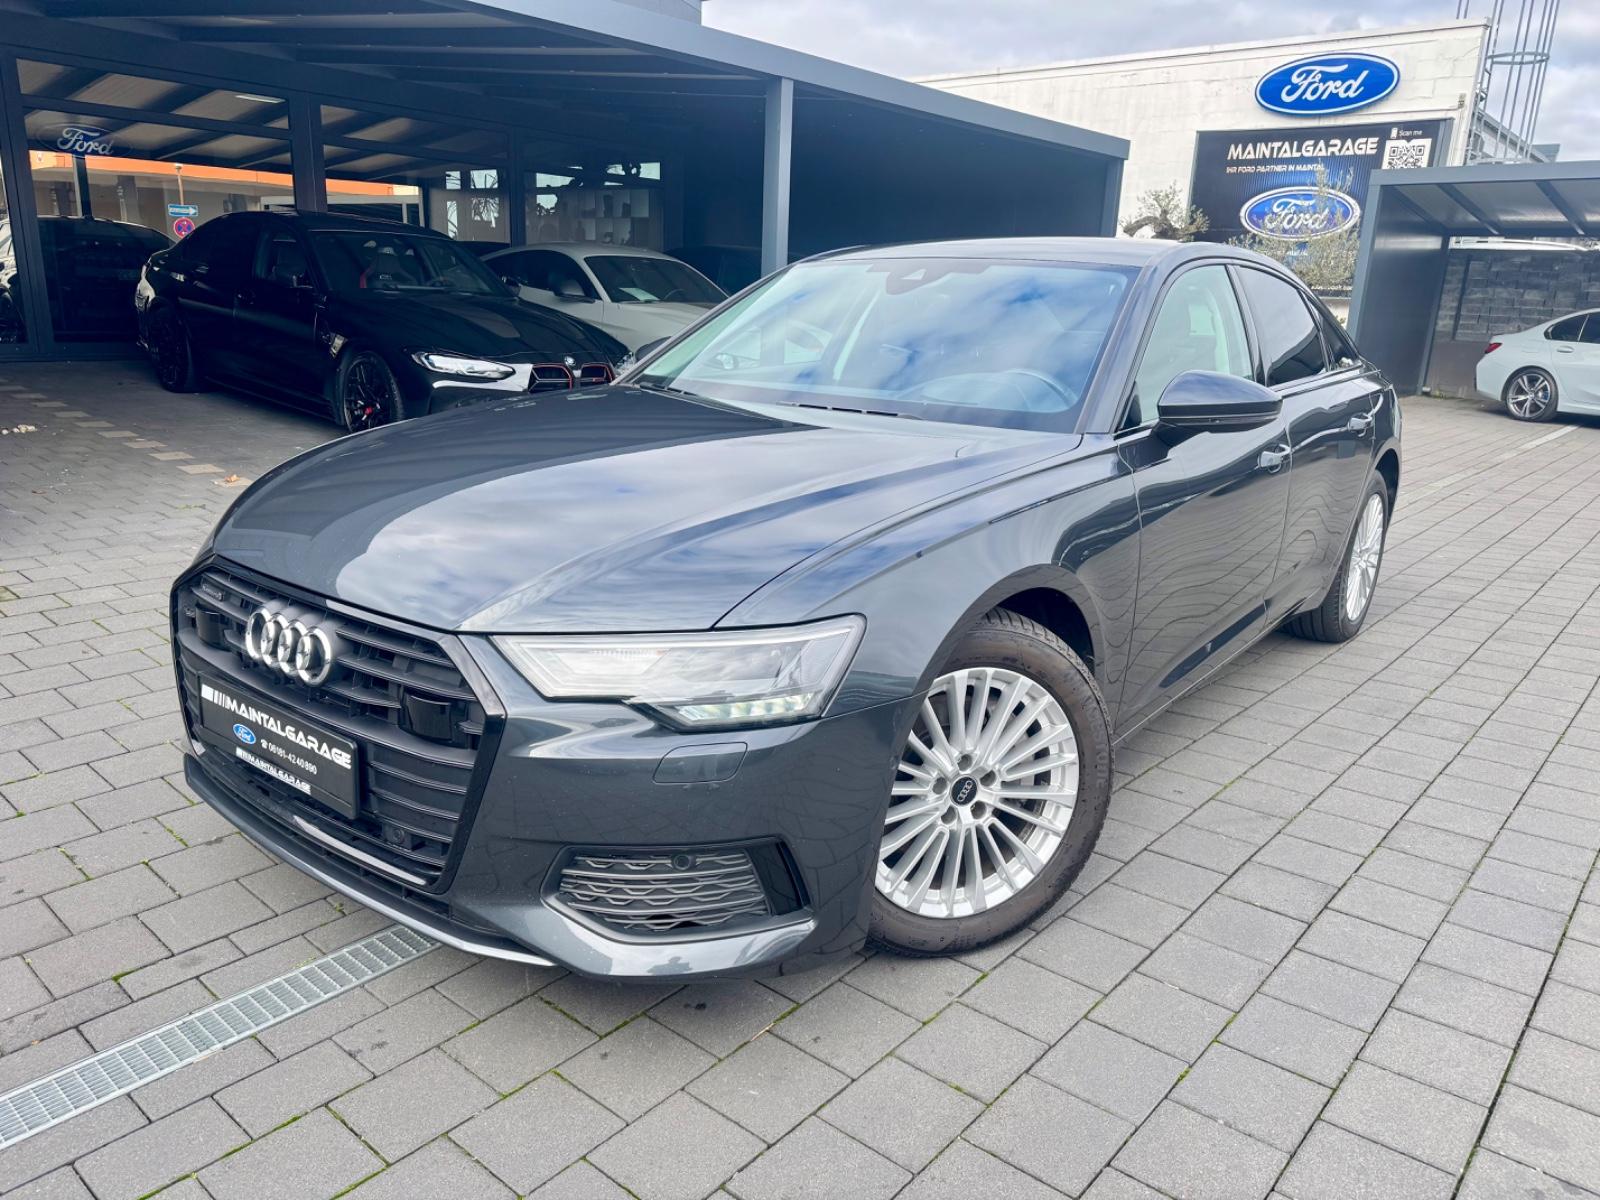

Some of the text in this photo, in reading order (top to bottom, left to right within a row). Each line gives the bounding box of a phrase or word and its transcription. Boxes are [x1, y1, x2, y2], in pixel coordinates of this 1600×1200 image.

[1281, 64, 1369, 103] Ford
[57, 128, 114, 154] Ford
[1227, 138, 1379, 160] MAINTALGARAGE
[1226, 166, 1237, 174] IHR
[1237, 166, 1256, 174] FORD
[1256, 164, 1287, 173] PARTNER
[1288, 164, 1295, 172] IN
[1264, 197, 1329, 229] Ford
[225, 697, 351, 769] MAINTALGARAGE
[249, 754, 311, 795] MAINTALGARAGE
